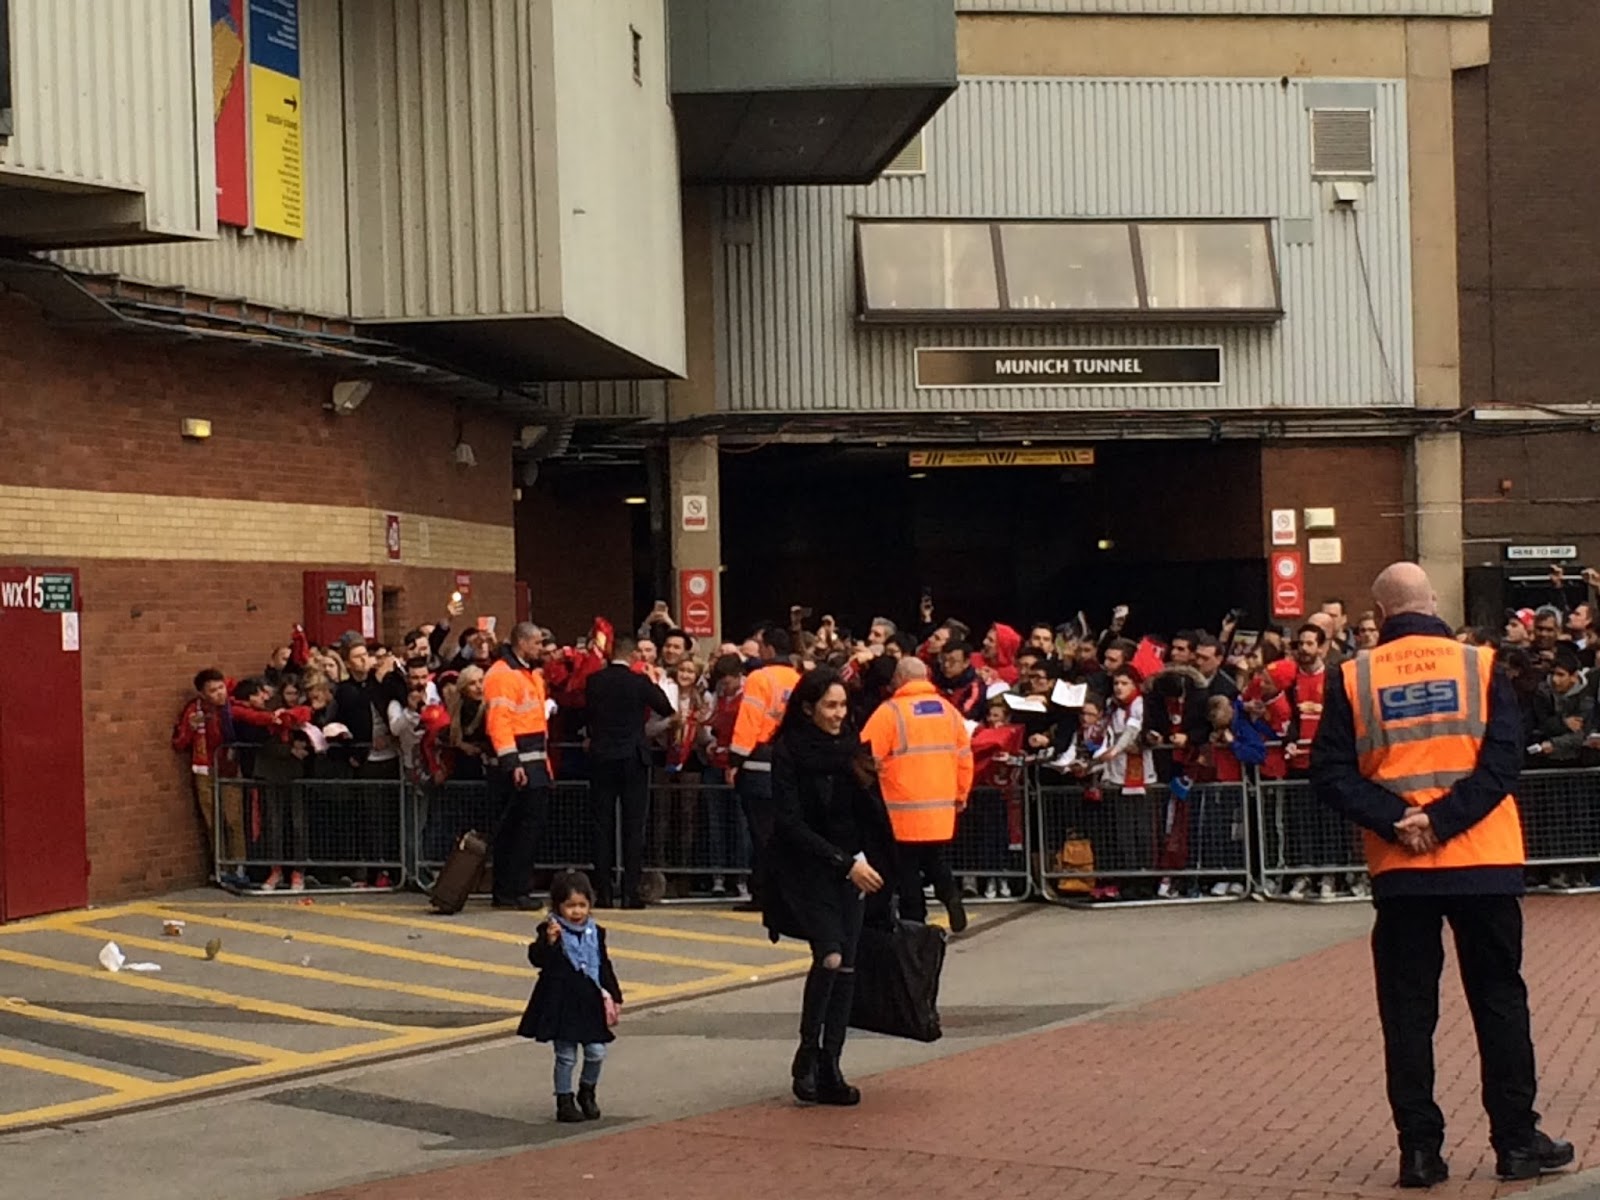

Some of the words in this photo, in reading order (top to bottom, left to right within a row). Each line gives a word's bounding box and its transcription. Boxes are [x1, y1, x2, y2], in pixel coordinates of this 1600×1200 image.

[995, 359, 1069, 374] MUNICH
[1073, 358, 1142, 373] TUNNEL
[1375, 646, 1456, 664] RESPONSE
[1396, 661, 1436, 674] TEAM
[1382, 681, 1454, 708] CES
